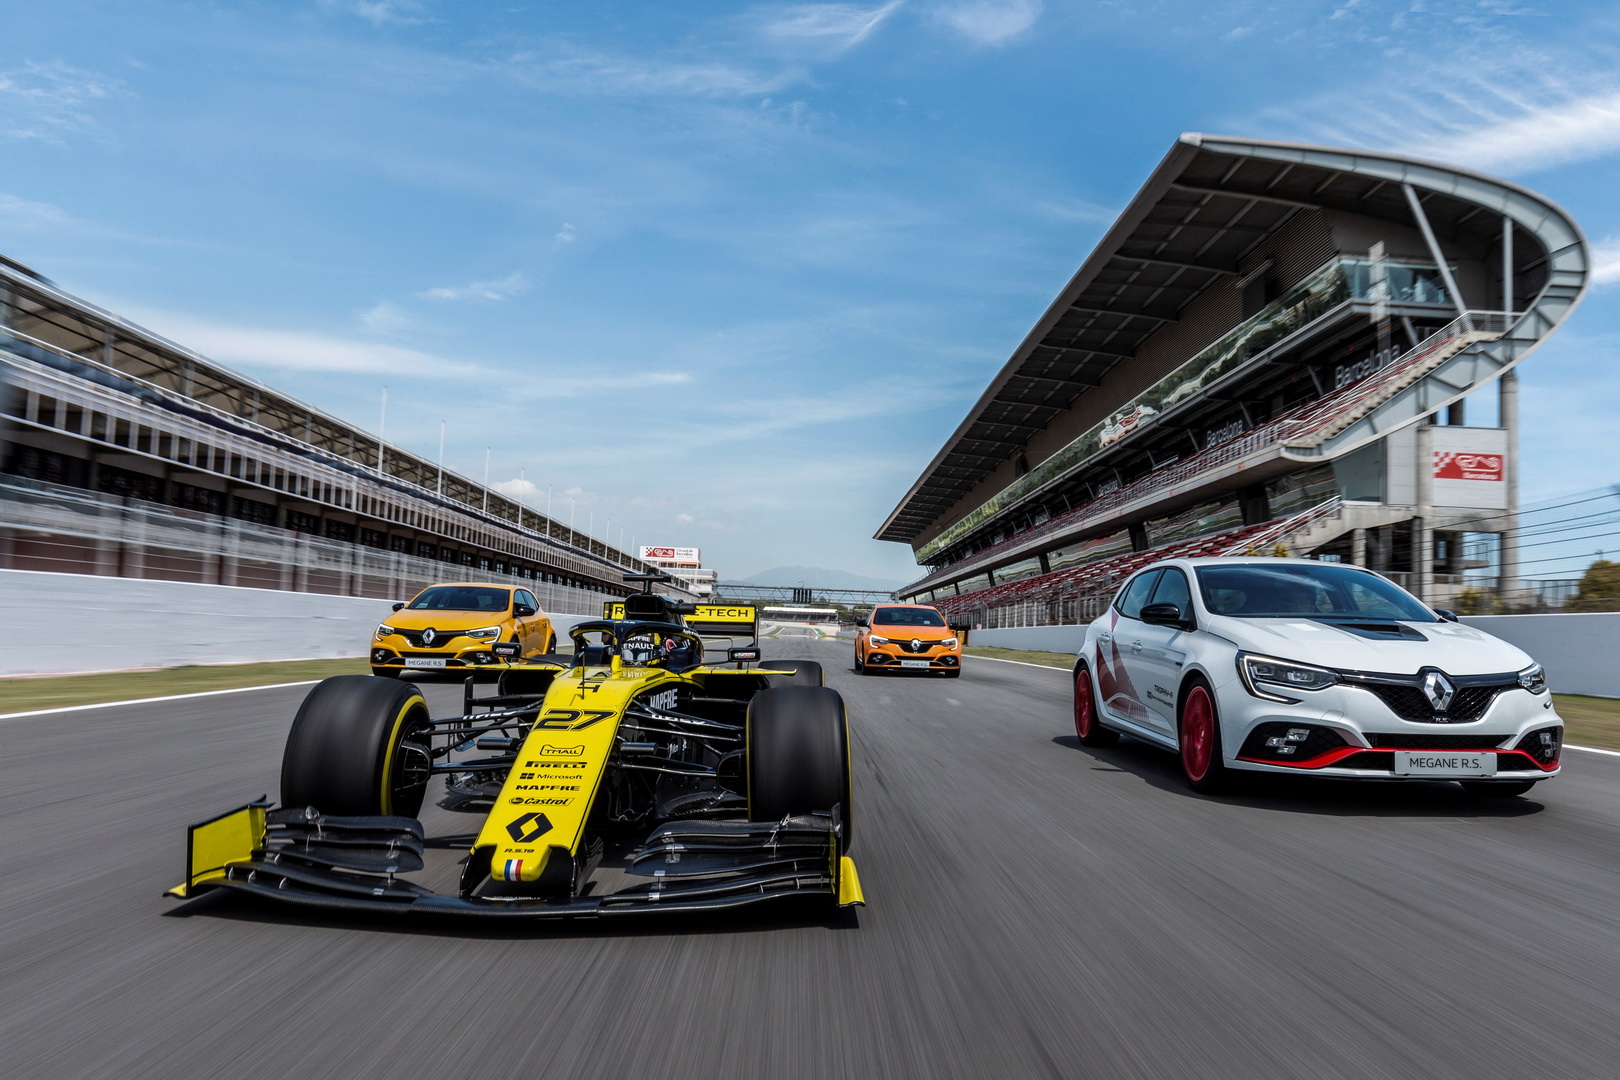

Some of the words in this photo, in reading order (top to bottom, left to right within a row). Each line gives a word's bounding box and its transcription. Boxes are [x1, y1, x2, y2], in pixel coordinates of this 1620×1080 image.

[1335, 343, 1400, 389] Barcelona
[1206, 419, 1243, 448] Barcelona
[650, 688, 678, 710] MAPFRE
[531, 708, 618, 731] 27
[1409, 757, 1458, 768] MEGANE
[1461, 758, 1482, 769] R.S.
[524, 797, 570, 805] Castrol
